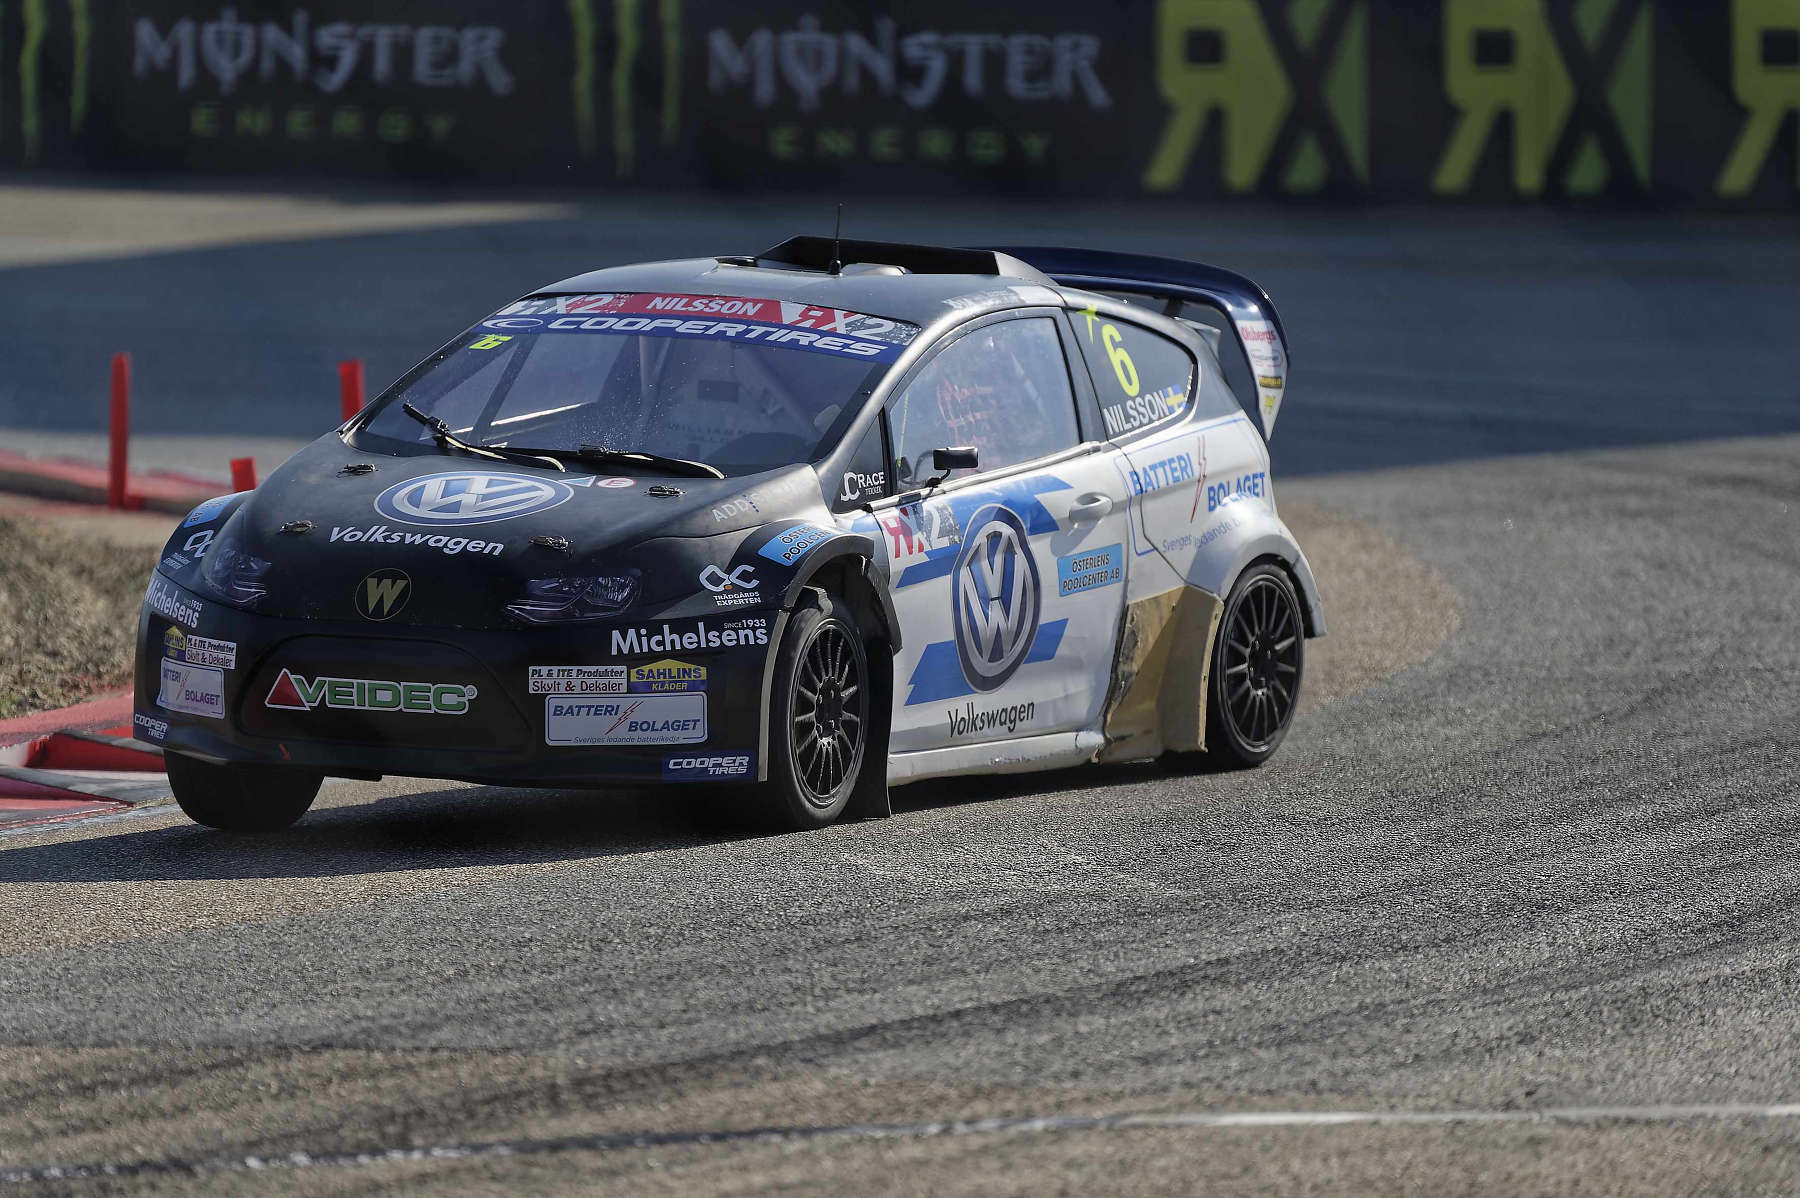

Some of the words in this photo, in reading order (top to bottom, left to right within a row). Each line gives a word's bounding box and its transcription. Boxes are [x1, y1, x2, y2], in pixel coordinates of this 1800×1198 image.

[133, 8, 512, 94] MONSTER
[708, 14, 1112, 110] MONSTER
[191, 104, 455, 142] ENERGY
[767, 124, 1051, 165] ENERGY
[646, 296, 763, 316] NILSSON
[1102, 323, 1140, 397] 6
[1103, 390, 1170, 435] NILSSON
[857, 471, 886, 488] RACE
[1129, 452, 1194, 496] BATTERI
[328, 525, 504, 555] Volkswagen
[1071, 552, 1110, 573] ÖSTERLENS
[1063, 571, 1108, 592] POOLCENTER
[1110, 568, 1120, 580] AB
[716, 597, 761, 606] EXPERTEN
[742, 619, 767, 628] 1933
[611, 622, 768, 655] Michelsens
[530, 668, 545, 678] PL
[556, 668, 573, 678] ITE
[575, 668, 625, 678] Produkter
[635, 666, 703, 681] SAHLINS
[290, 674, 469, 715] VEIDEC
[532, 680, 563, 692] Skylt
[564, 680, 576, 692] &
[580, 680, 623, 692] Dekaler
[185, 689, 220, 706] BOLAGET
[552, 704, 620, 717] BATTERI
[948, 701, 1035, 738] Volkswagen
[135, 713, 168, 733] COOPER
[627, 718, 701, 733] BOLAGET
[573, 736, 605, 745] Sveriges
[668, 756, 750, 770] COOPER
[708, 767, 748, 775] TIRES
